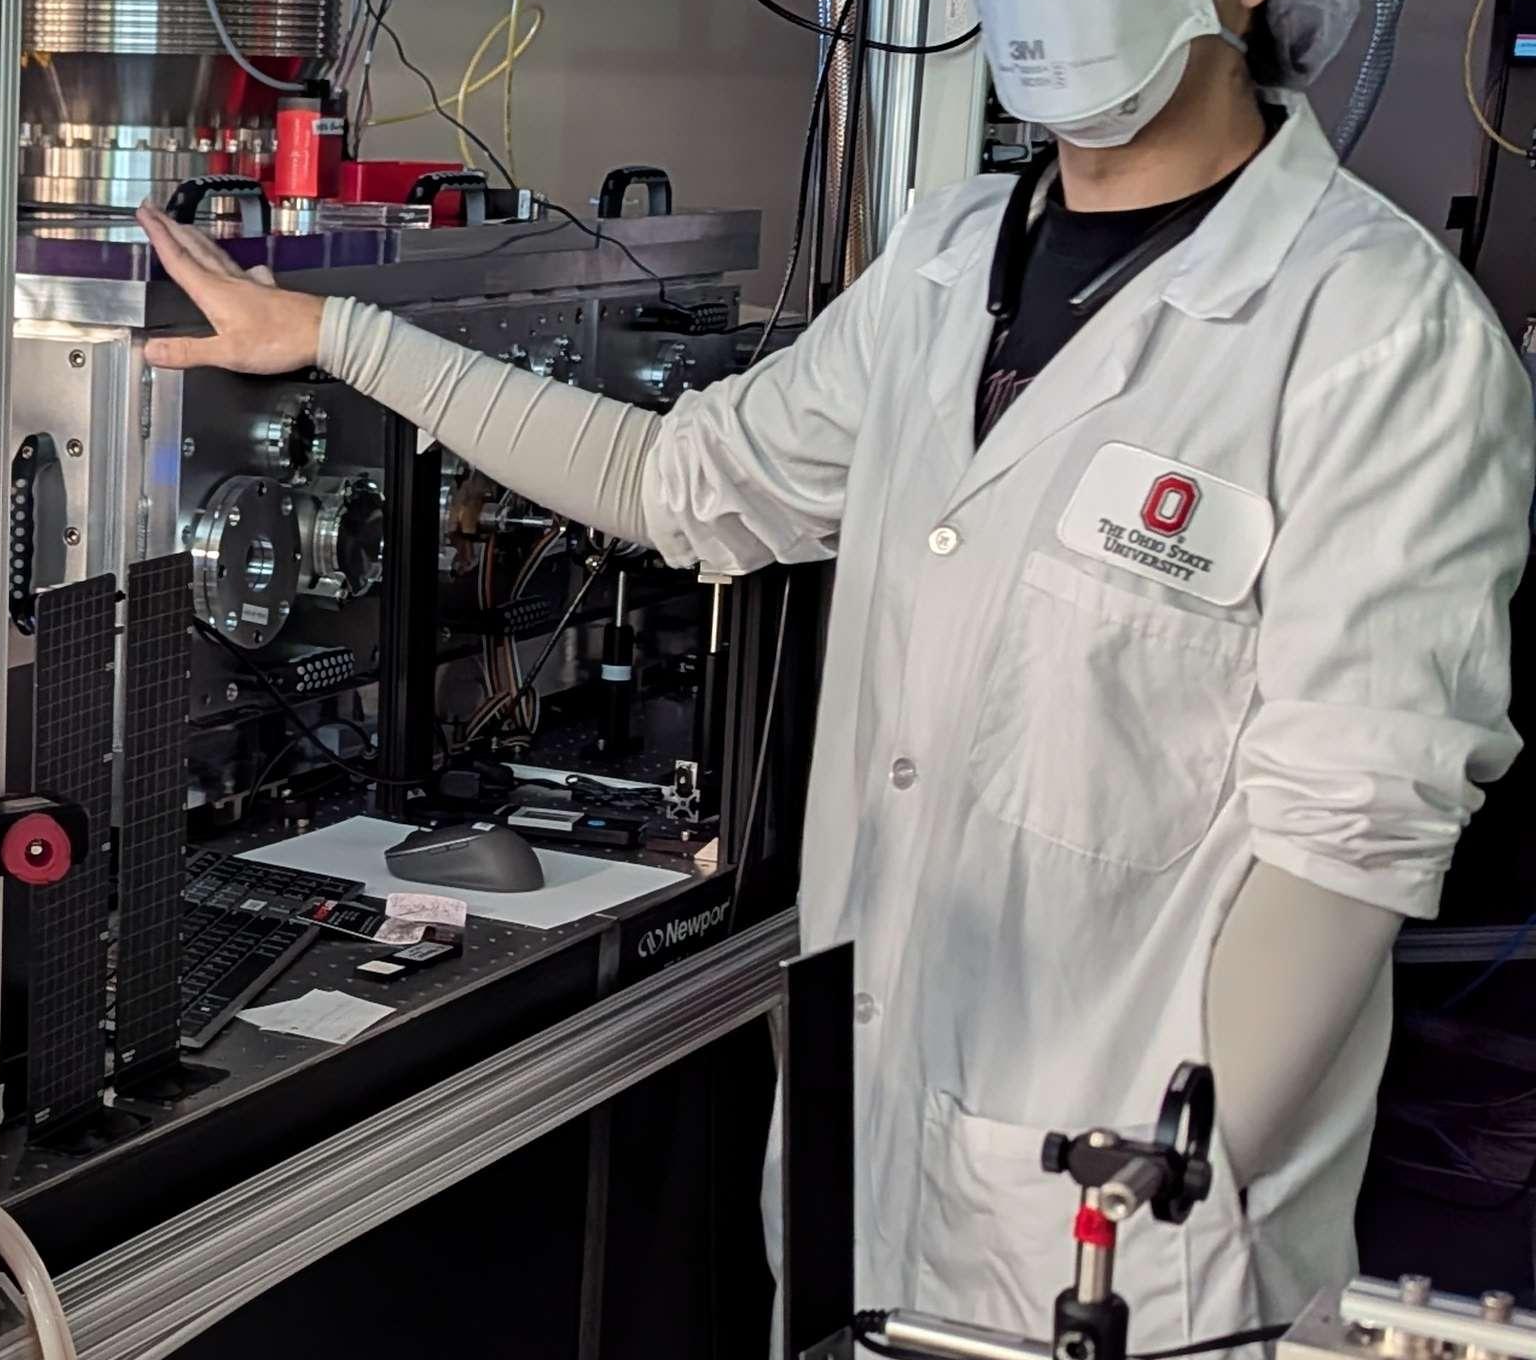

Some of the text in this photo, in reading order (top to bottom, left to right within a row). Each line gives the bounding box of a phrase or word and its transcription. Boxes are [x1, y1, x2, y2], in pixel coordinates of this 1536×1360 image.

[1009, 39, 1045, 61] 3M
[1140, 471, 1202, 537] O
[1097, 518, 1213, 573] THE OHIO STATE
[1103, 537, 1195, 581] UNIVERSITY
[665, 897, 731, 947] Newpor
